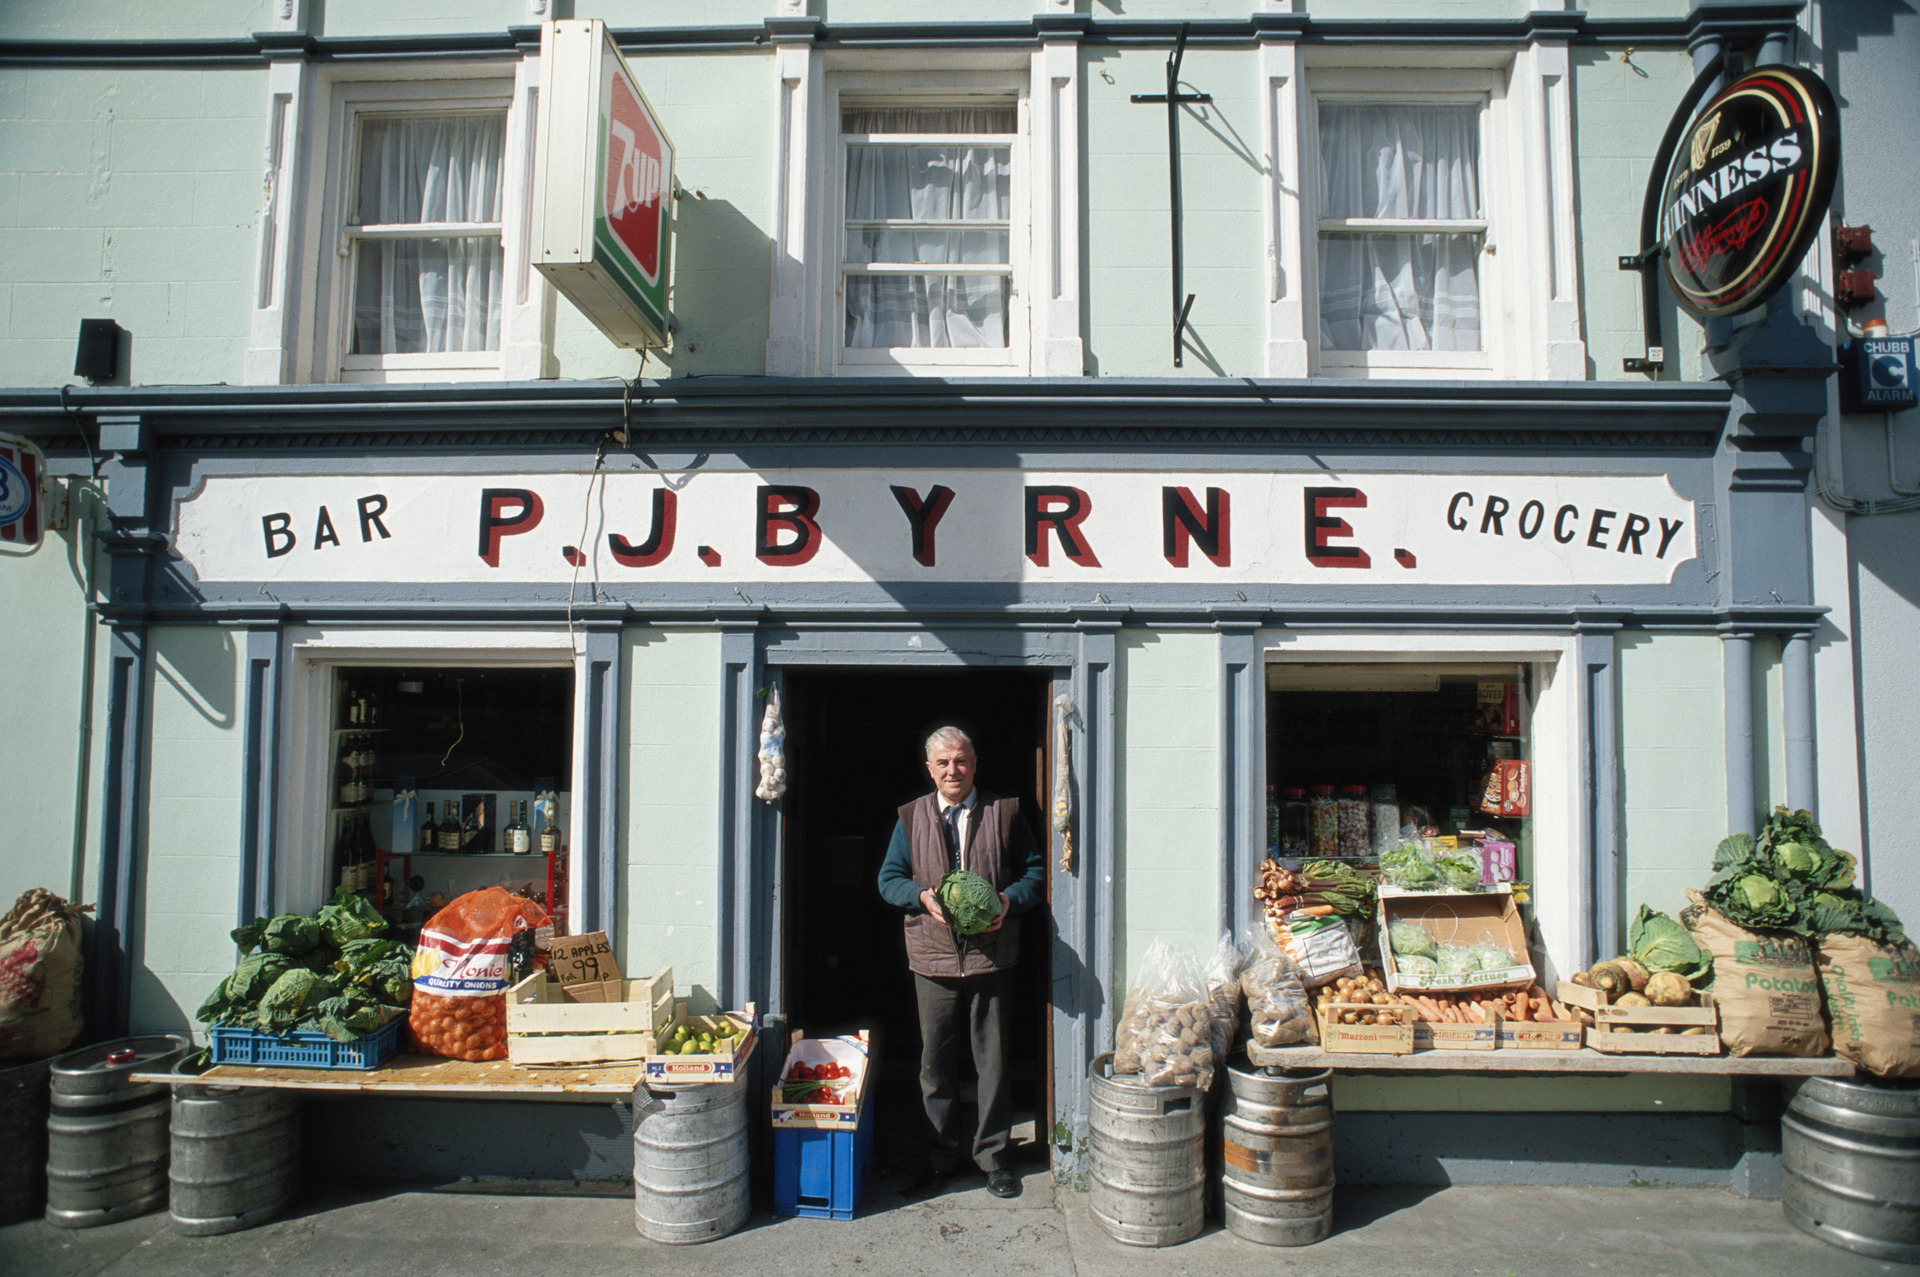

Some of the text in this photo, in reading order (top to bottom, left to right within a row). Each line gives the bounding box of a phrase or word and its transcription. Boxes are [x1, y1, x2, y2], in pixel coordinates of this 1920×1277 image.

[1662, 131, 1802, 249] UINNESS
[1863, 341, 1910, 353] CHUBB
[1867, 389, 1914, 401] ALARM
[262, 493, 392, 559] BAR
[1446, 491, 1684, 560] GROCERY
[553, 942, 609, 960] 12 APPLES
[428, 977, 497, 989] QUALITY ONIONS
[1418, 971, 1509, 987] Fresh Lettuce
[1339, 1032, 1377, 1041] Mazzoni
[672, 1064, 705, 1072] Holland
[799, 1111, 831, 1119] Holland
